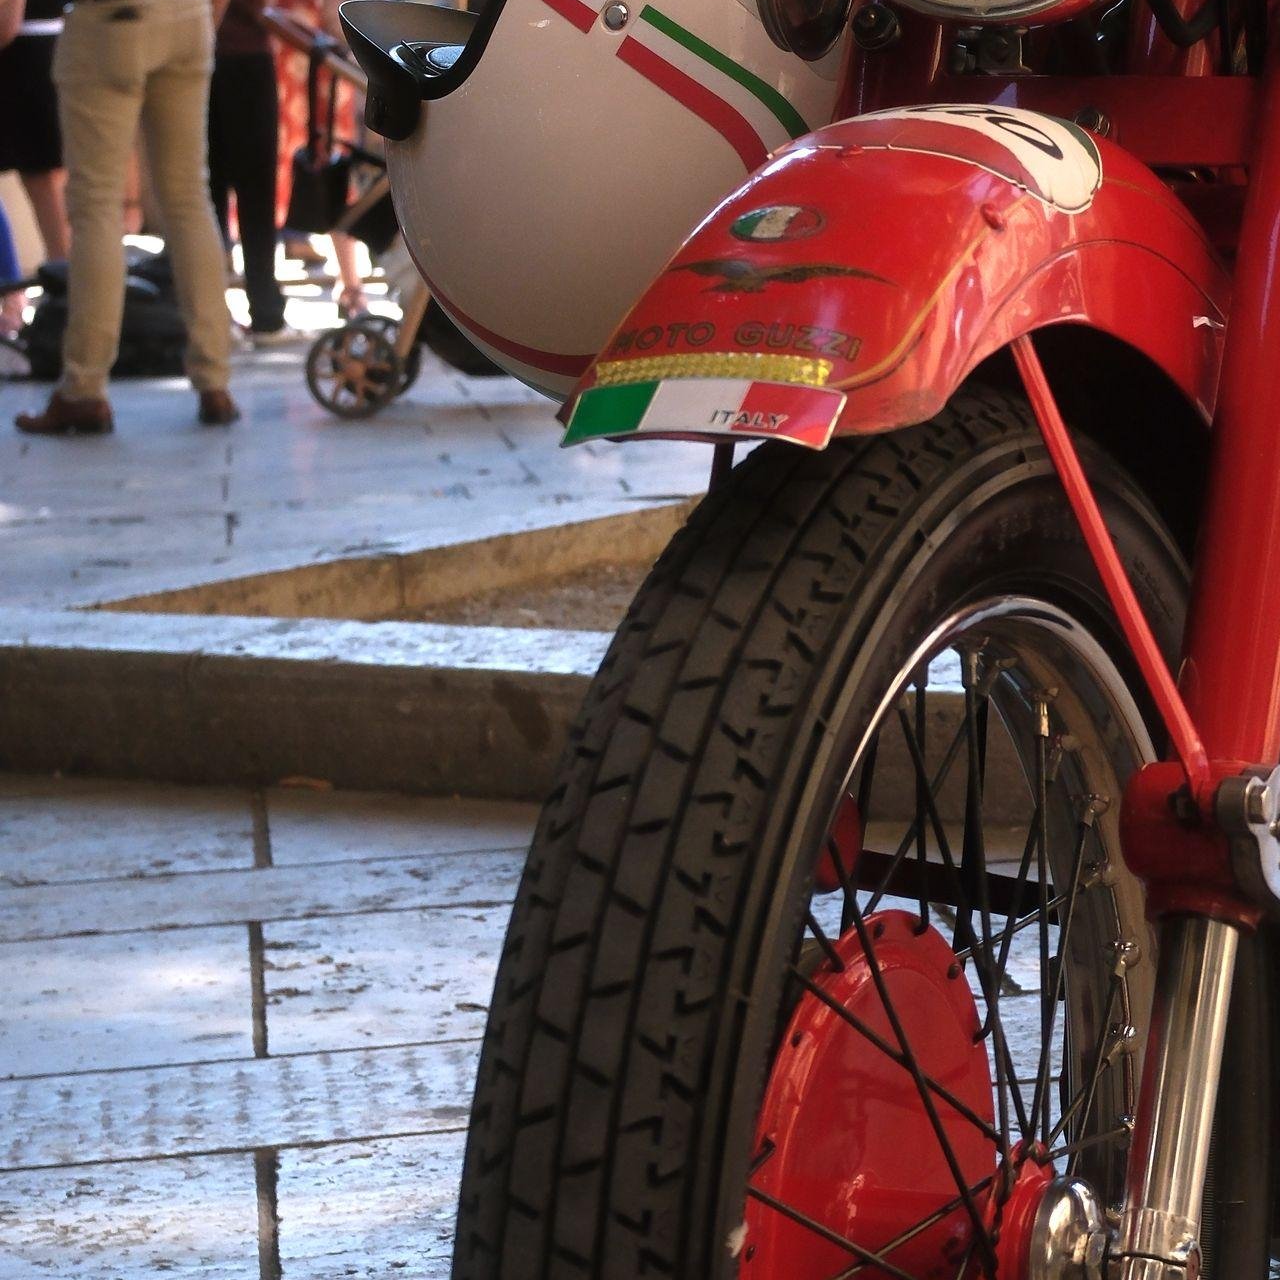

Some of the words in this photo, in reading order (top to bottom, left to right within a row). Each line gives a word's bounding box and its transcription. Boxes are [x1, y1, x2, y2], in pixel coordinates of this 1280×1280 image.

[607, 321, 716, 357] MOTO
[734, 321, 863, 363] GUZZI
[711, 408, 790, 429] ITALY
